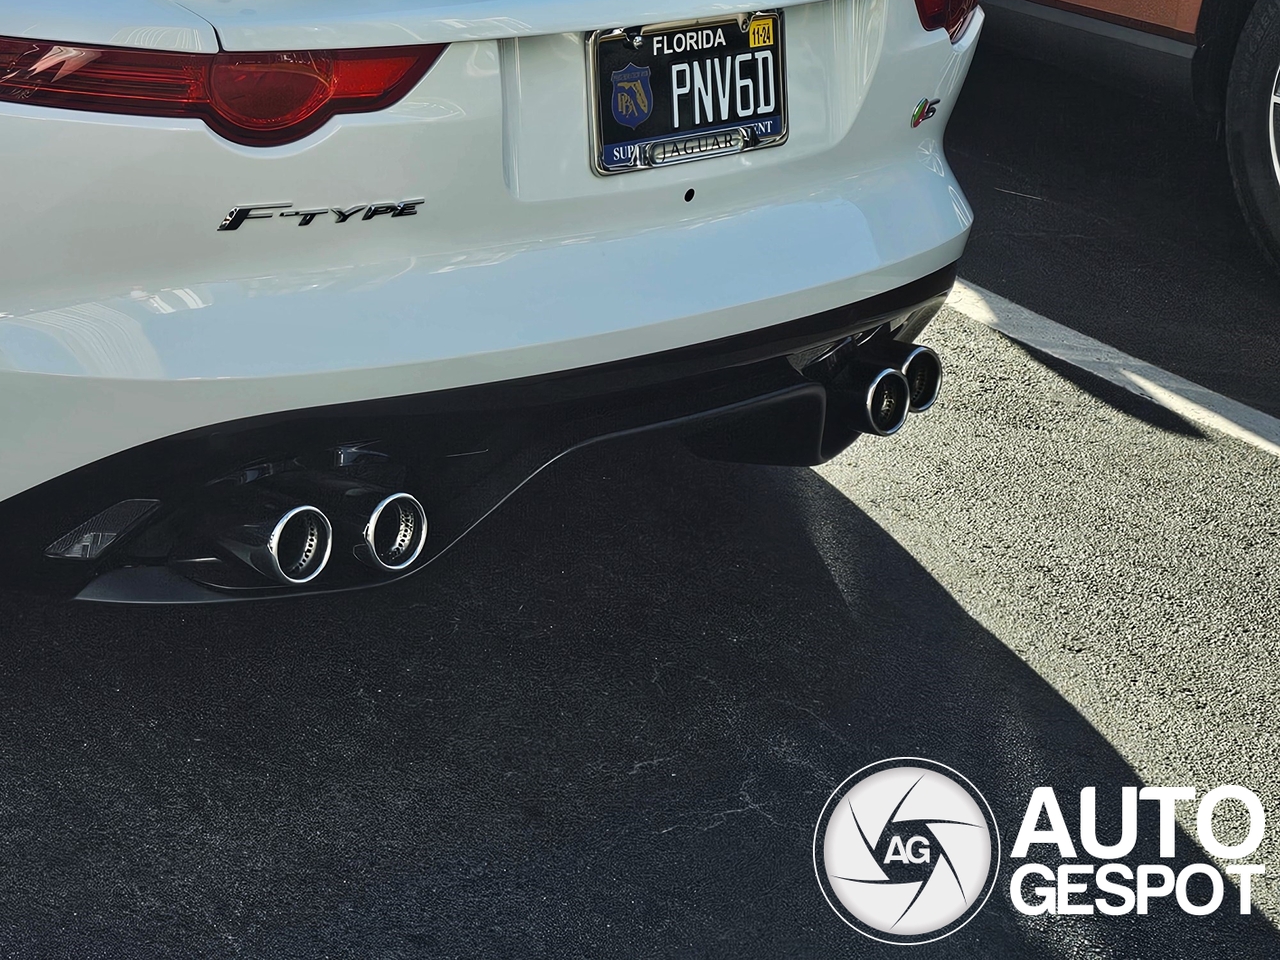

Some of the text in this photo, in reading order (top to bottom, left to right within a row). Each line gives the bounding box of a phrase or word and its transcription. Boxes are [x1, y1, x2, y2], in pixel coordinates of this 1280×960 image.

[652, 28, 726, 56] FLORIDA
[671, 49, 776, 129] PNV6D
[661, 132, 734, 163] JAGUAR
